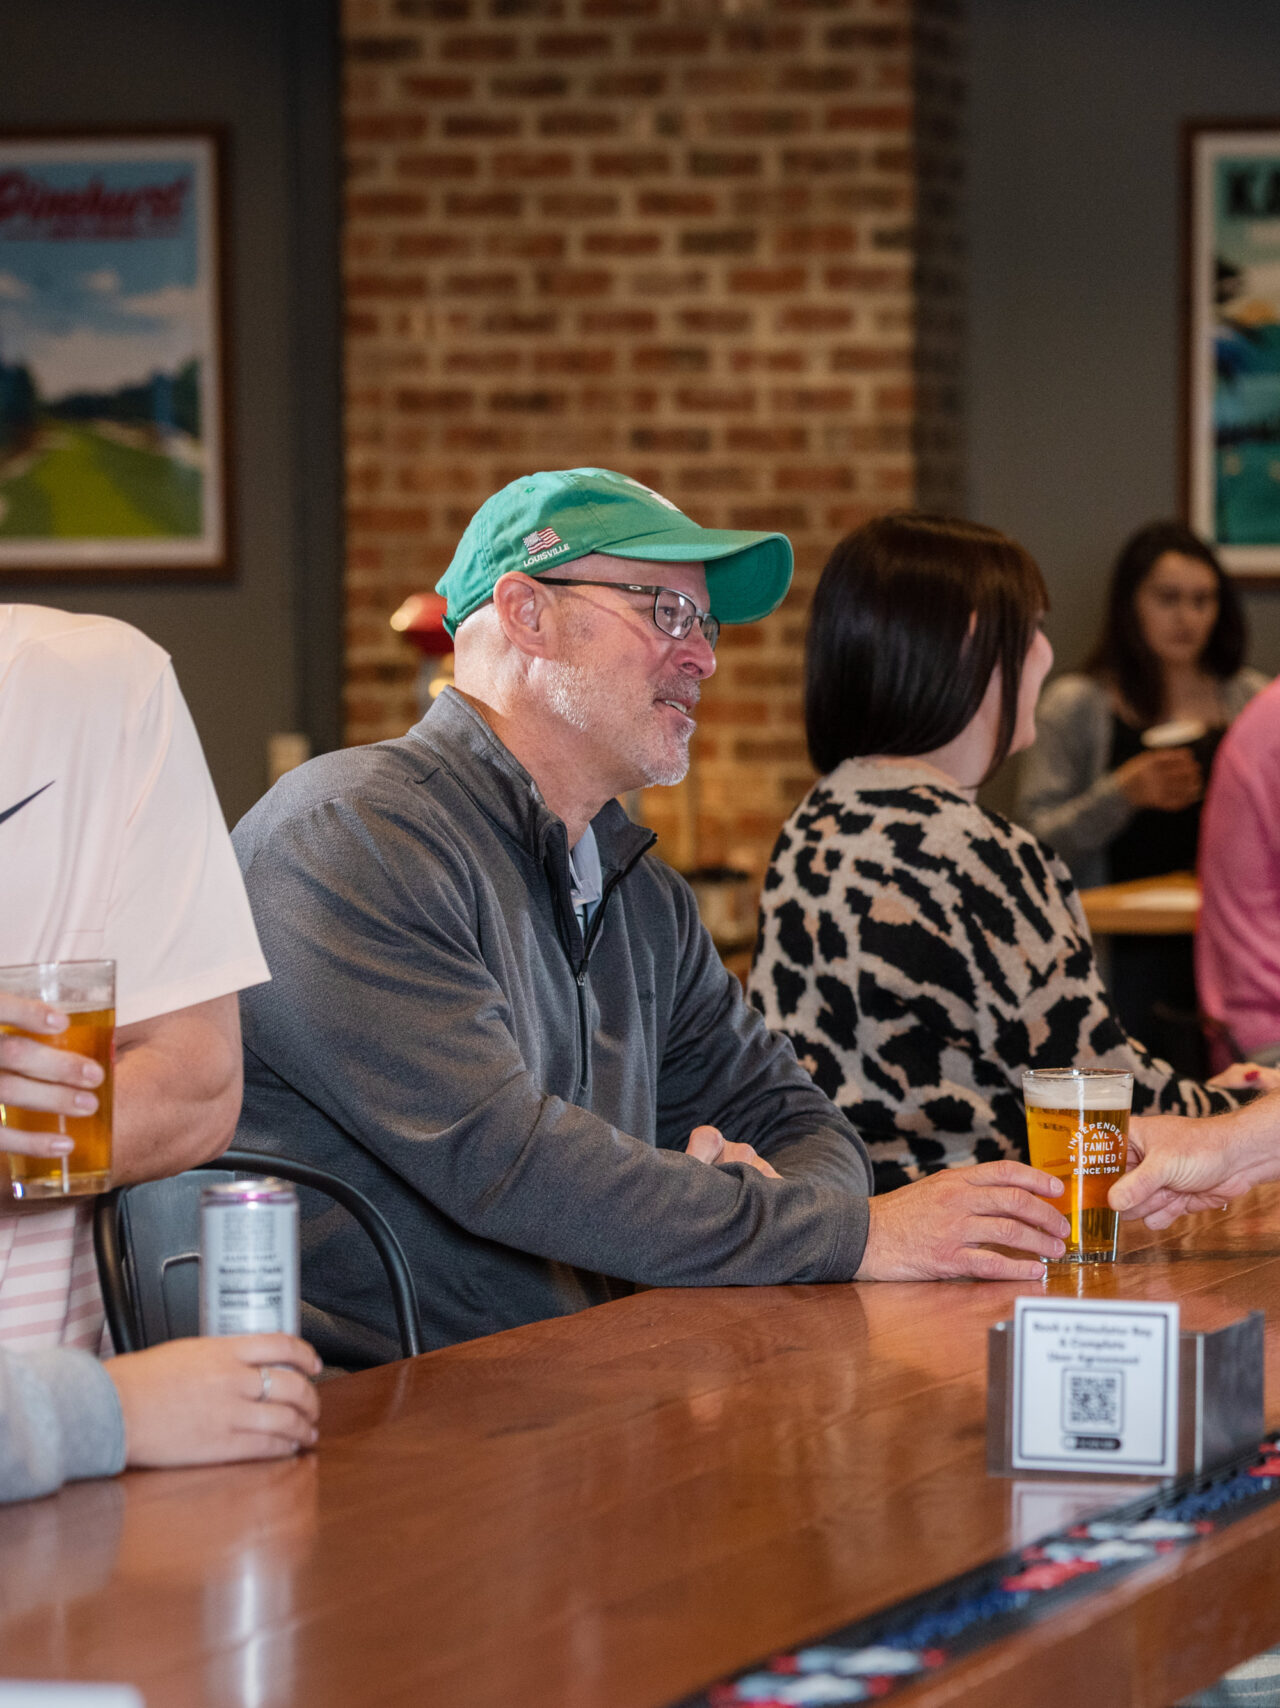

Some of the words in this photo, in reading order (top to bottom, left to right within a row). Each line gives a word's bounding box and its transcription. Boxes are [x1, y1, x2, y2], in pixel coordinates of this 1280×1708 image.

[523, 543, 570, 568] LOUISVILLE
[1067, 1121, 1124, 1150] INDEPENDENT
[1091, 1131, 1110, 1141] AVL
[1084, 1141, 1114, 1151] FAMILY
[1080, 1154, 1116, 1165] OWNED
[1073, 1167, 1101, 1175] SINCE
[1103, 1166, 1120, 1174] 1994
